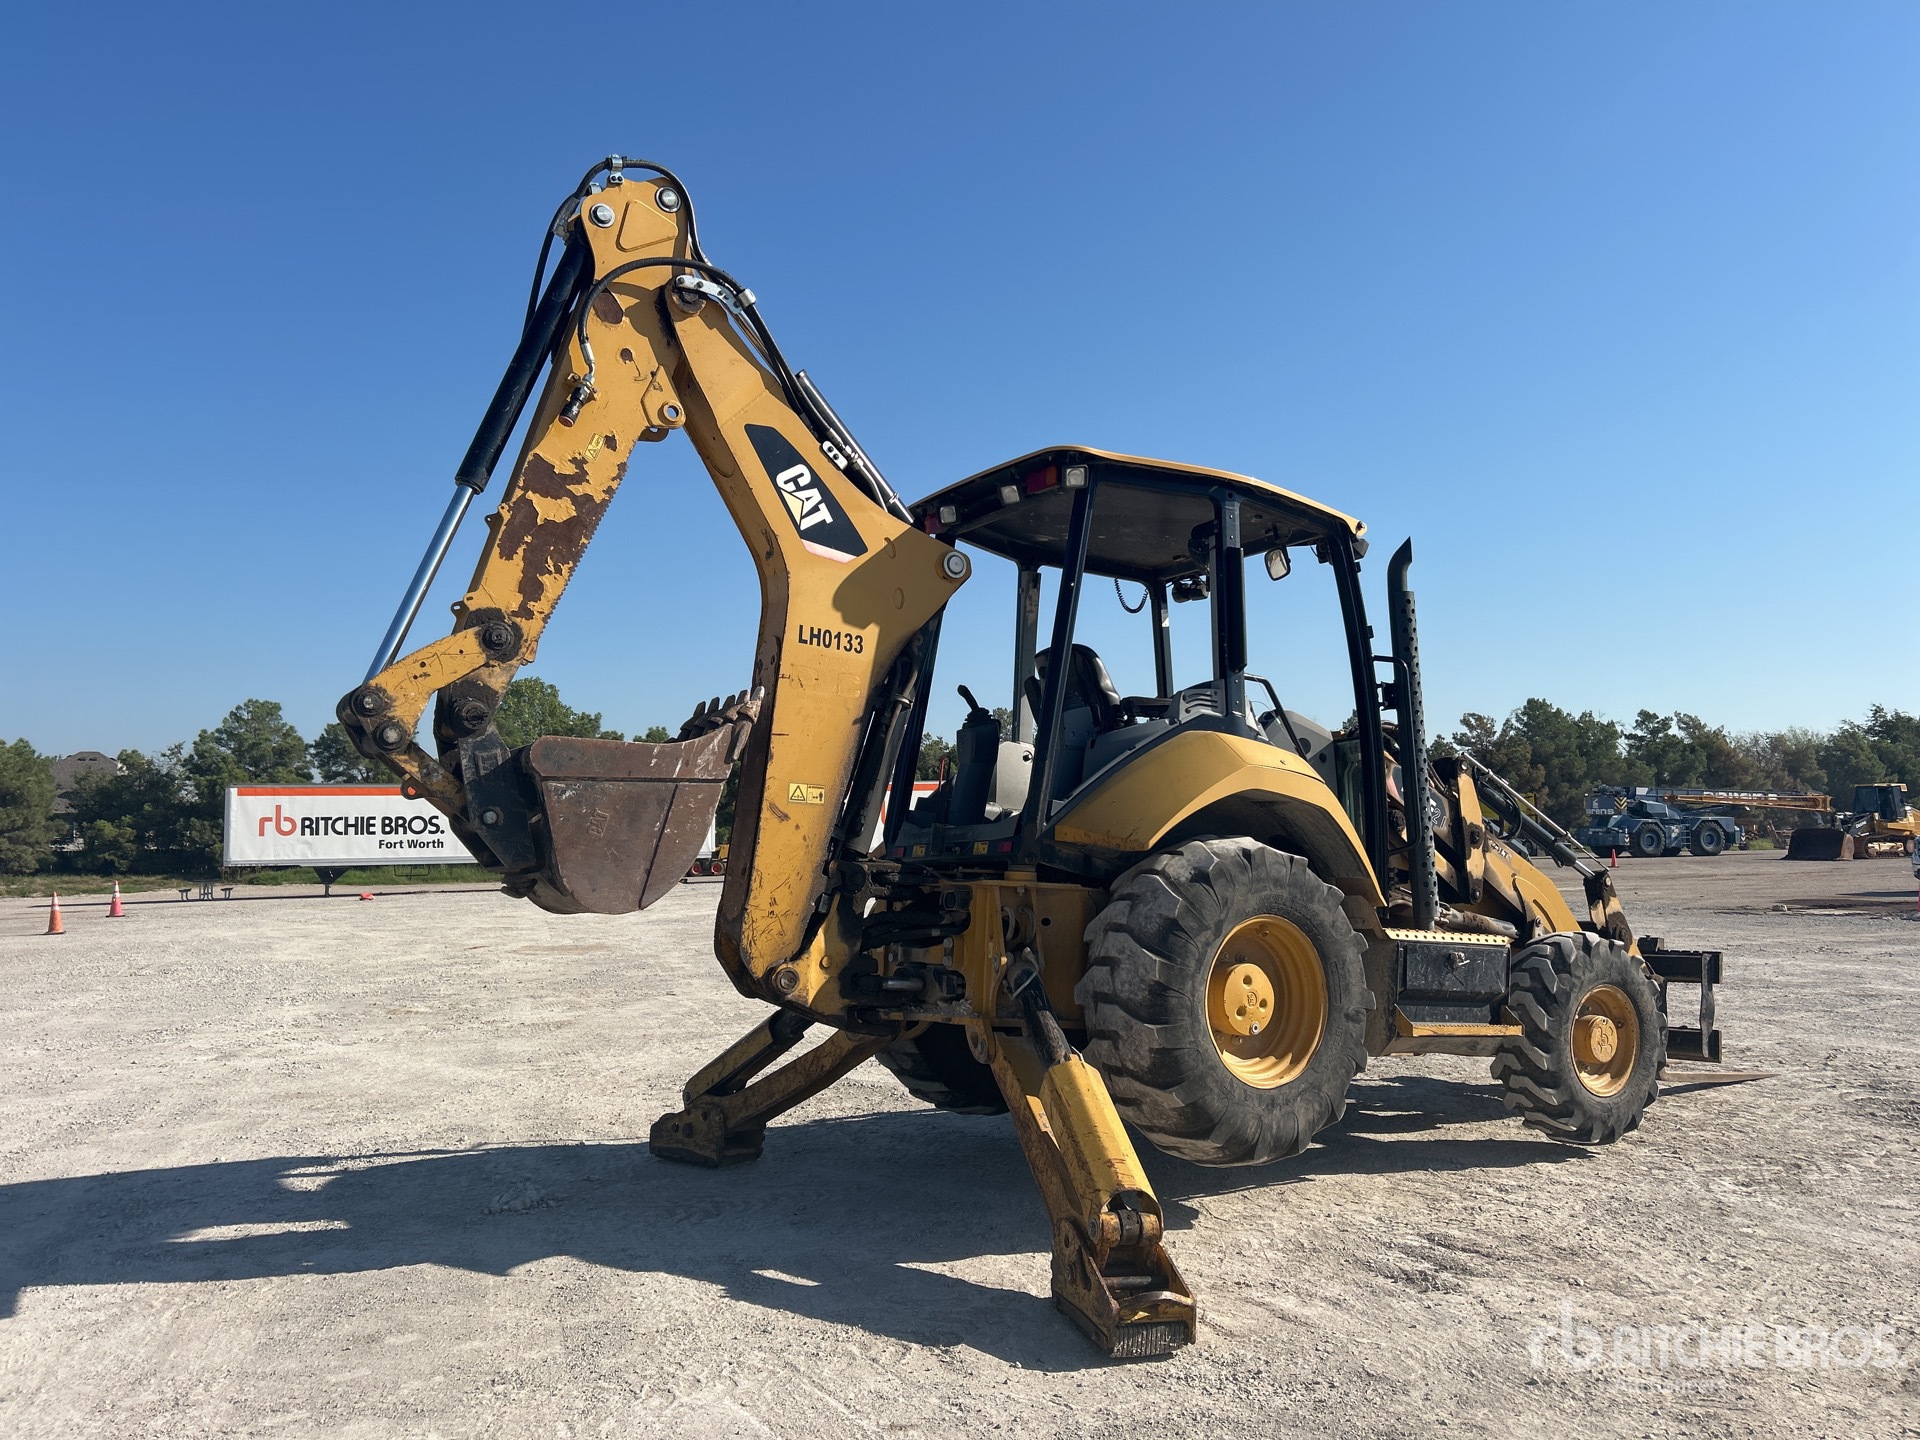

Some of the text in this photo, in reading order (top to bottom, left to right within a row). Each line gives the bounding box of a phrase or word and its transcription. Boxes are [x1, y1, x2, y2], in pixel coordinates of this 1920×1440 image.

[776, 463, 833, 531] CAT
[798, 624, 864, 655] LH0133
[300, 816, 376, 836] RITCHIE
[381, 815, 445, 836] BROS.
[378, 838, 444, 850] Fort Worth
